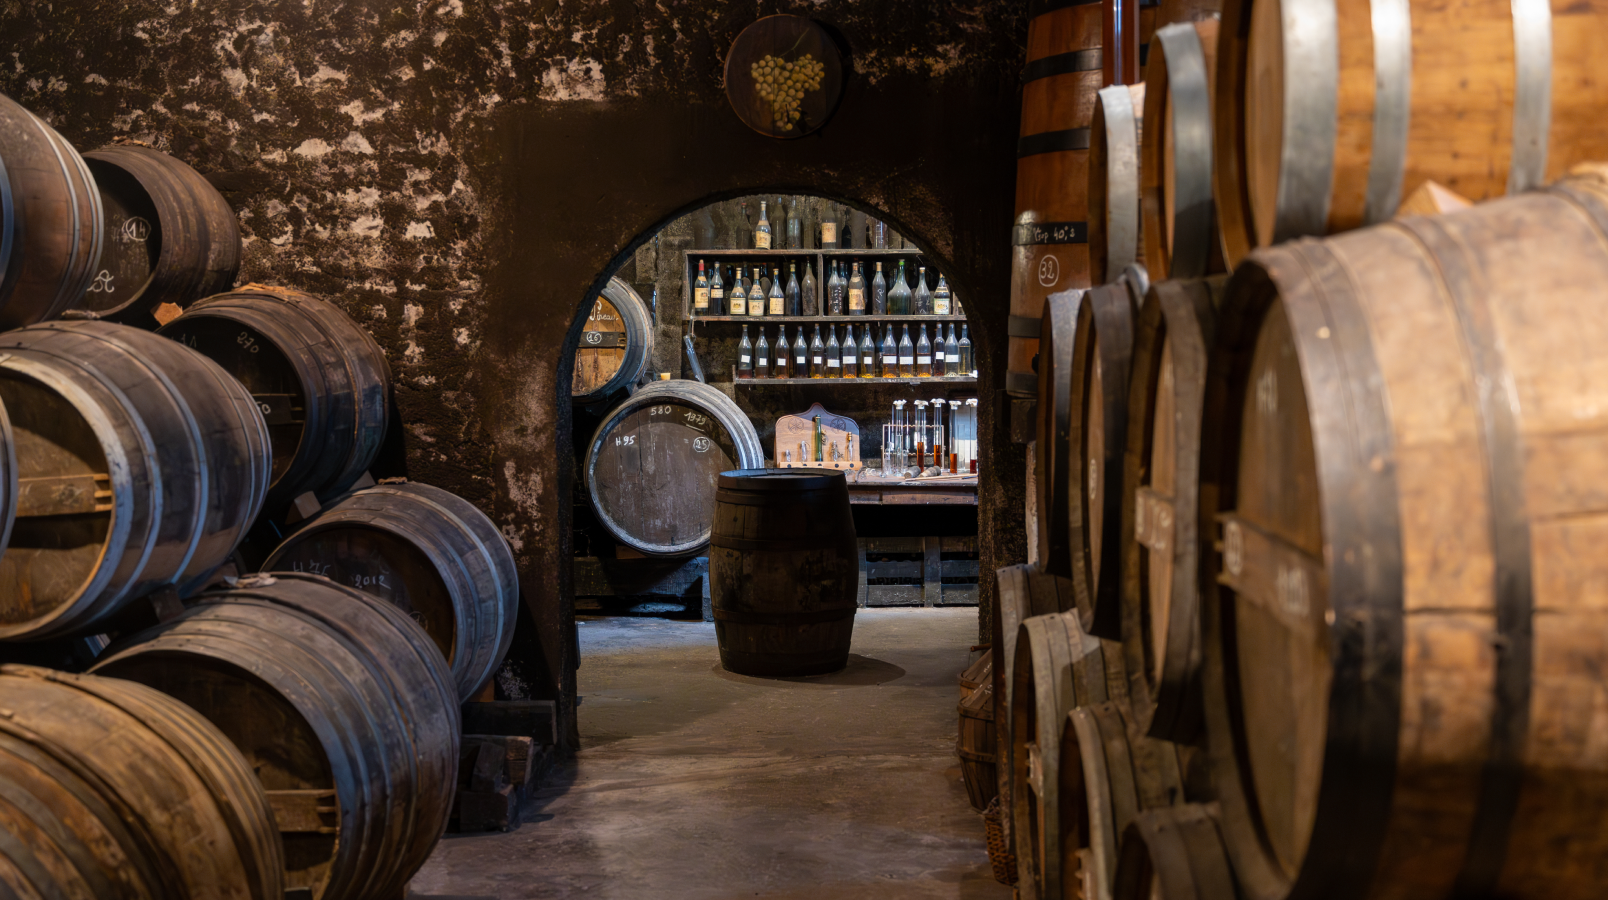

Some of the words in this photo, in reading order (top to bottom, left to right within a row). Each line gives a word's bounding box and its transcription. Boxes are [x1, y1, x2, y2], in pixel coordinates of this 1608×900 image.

[128, 220, 147, 239] 14
[1040, 259, 1056, 280] 32
[237, 331, 260, 353] 270
[588, 333, 601, 343] 16
[650, 405, 672, 416] 580
[683, 411, 706, 425] 1979
[695, 439, 708, 450] 25
[354, 574, 392, 590] 2012
